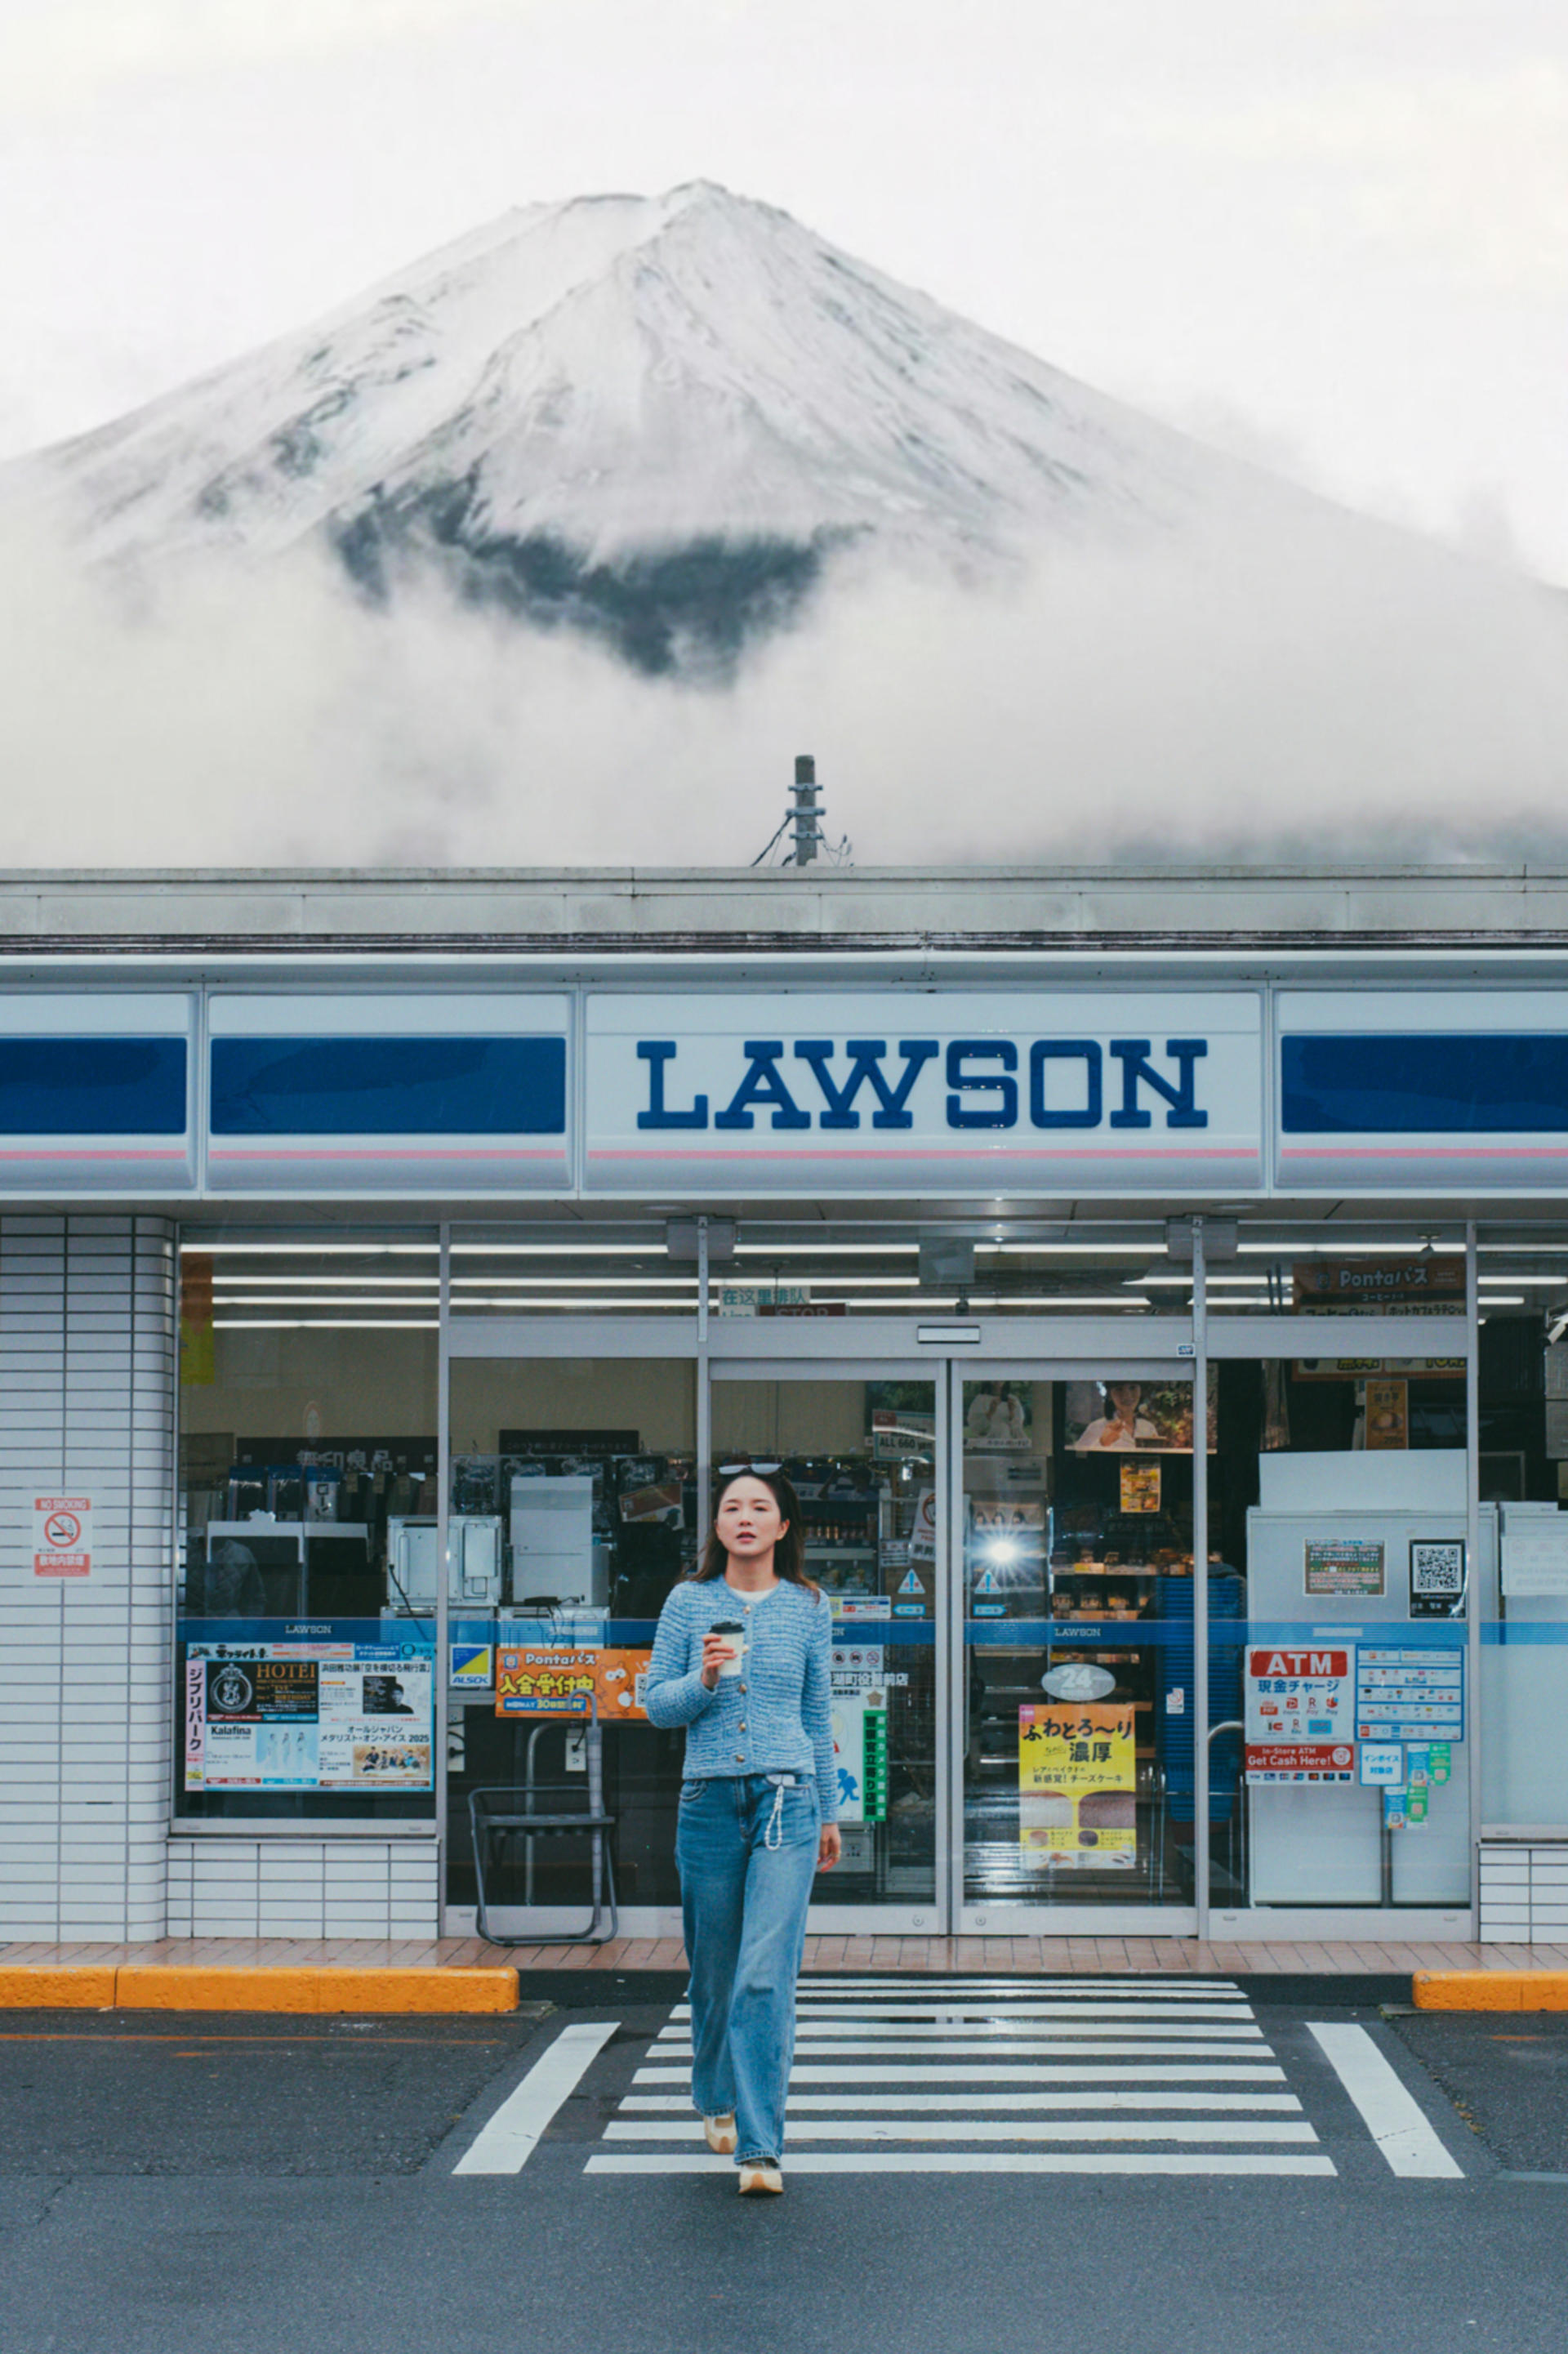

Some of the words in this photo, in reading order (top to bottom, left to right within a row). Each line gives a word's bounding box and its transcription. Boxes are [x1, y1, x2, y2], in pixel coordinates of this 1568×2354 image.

[636, 1039, 1208, 1130] LAWSON
[296, 1449, 393, 1472] 無印良品
[41, 1498, 53, 1509] NO
[54, 1498, 87, 1509] SMOKING
[285, 1625, 332, 1634] LAWSON
[1054, 1627, 1101, 1637] LAWSON
[525, 1652, 596, 1665] Pontaパス
[1267, 1652, 1332, 1674] ATM
[256, 1664, 316, 1679] HOTEI
[1062, 1668, 1092, 1688] 24
[452, 1676, 489, 1684] ALSOK
[1258, 1679, 1340, 1693] 現金チャージ
[189, 1668, 203, 1751] ジブリパーク
[211, 1725, 252, 1736] Kalafina
[408, 1734, 430, 1743] 2025
[1069, 1741, 1112, 1763] 濃厚
[1263, 1747, 1296, 1755] In-Store
[1298, 1747, 1316, 1755] ATM
[1248, 1755, 1267, 1766] Get
[1269, 1756, 1297, 1766] Cash
[1299, 1755, 1331, 1766] Here!
